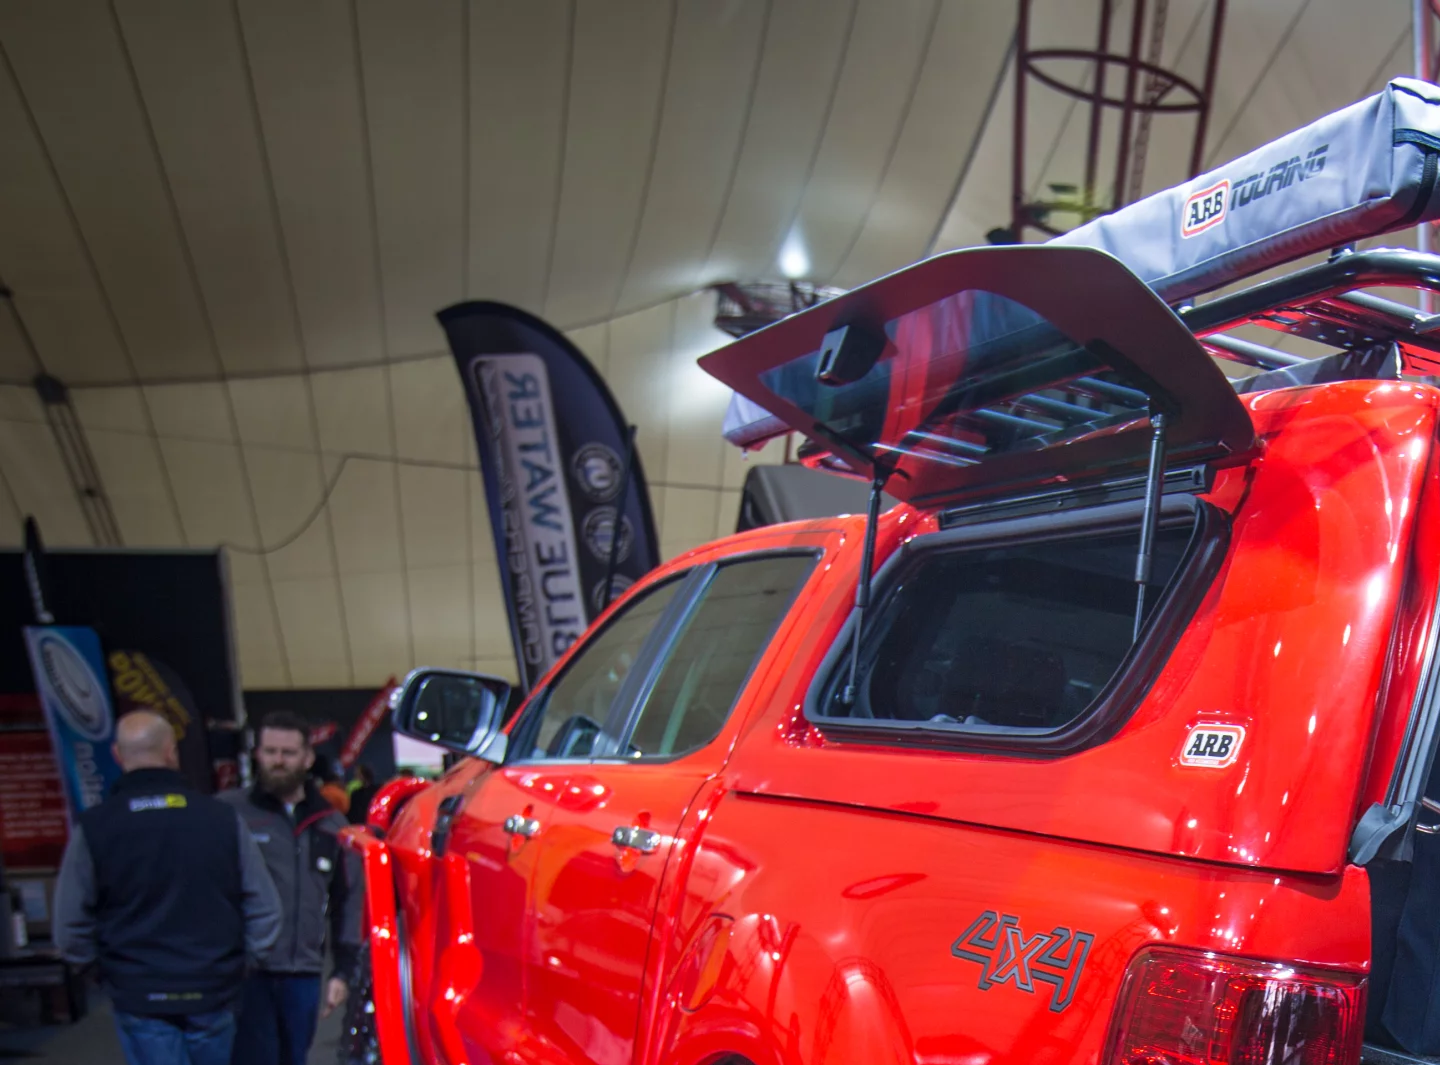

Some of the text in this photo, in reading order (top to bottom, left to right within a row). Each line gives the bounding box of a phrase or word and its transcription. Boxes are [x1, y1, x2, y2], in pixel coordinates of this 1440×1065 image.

[1188, 144, 1329, 227] ARB TOURING
[1187, 733, 1233, 757] ARB
[951, 910, 1095, 1013] 4x4
